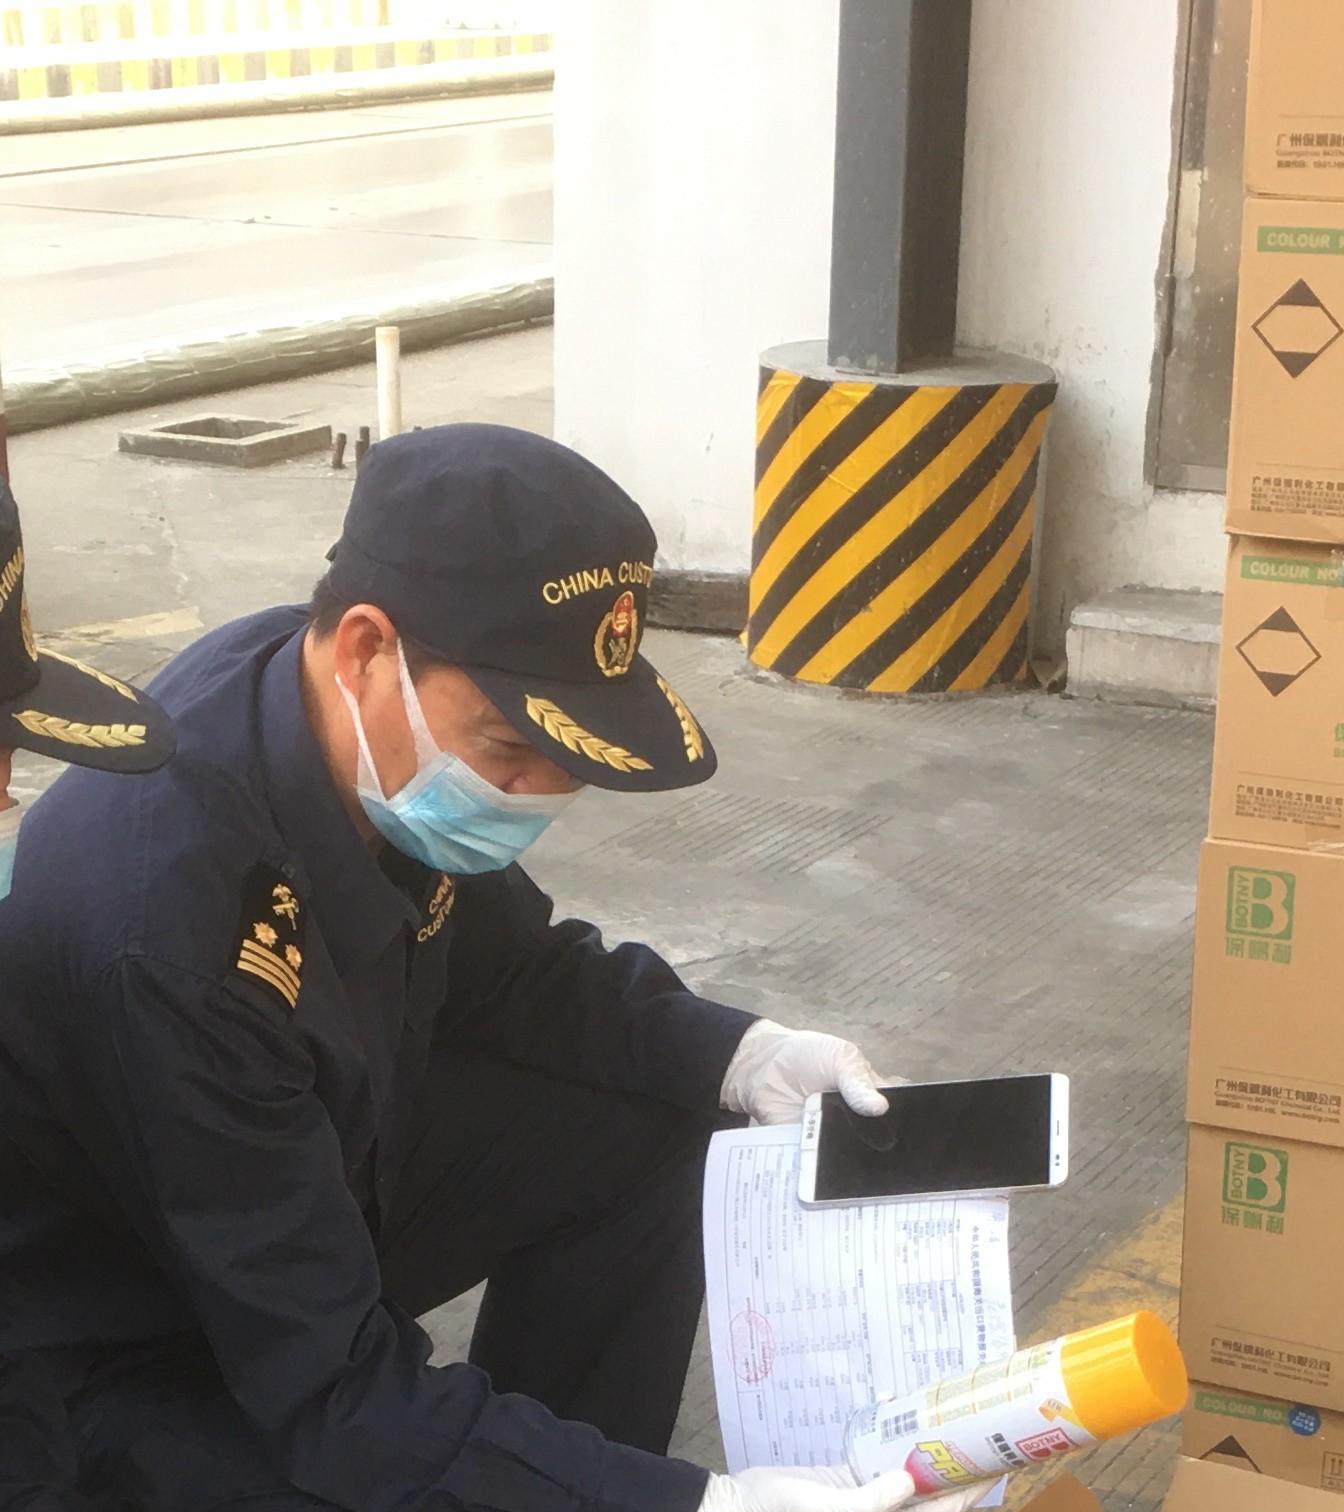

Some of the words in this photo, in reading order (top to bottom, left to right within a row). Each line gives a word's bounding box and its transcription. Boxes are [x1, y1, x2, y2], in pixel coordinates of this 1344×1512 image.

[1265, 230, 1329, 249] COLOUR
[1248, 560, 1308, 580] COLOUR
[542, 567, 615, 604] CHINA
[1234, 873, 1249, 929] BOTNY
[1230, 1147, 1245, 1200] BOTNY
[1201, 1396, 1256, 1417] COLOUR
[1024, 1431, 1063, 1451] BOTNY
